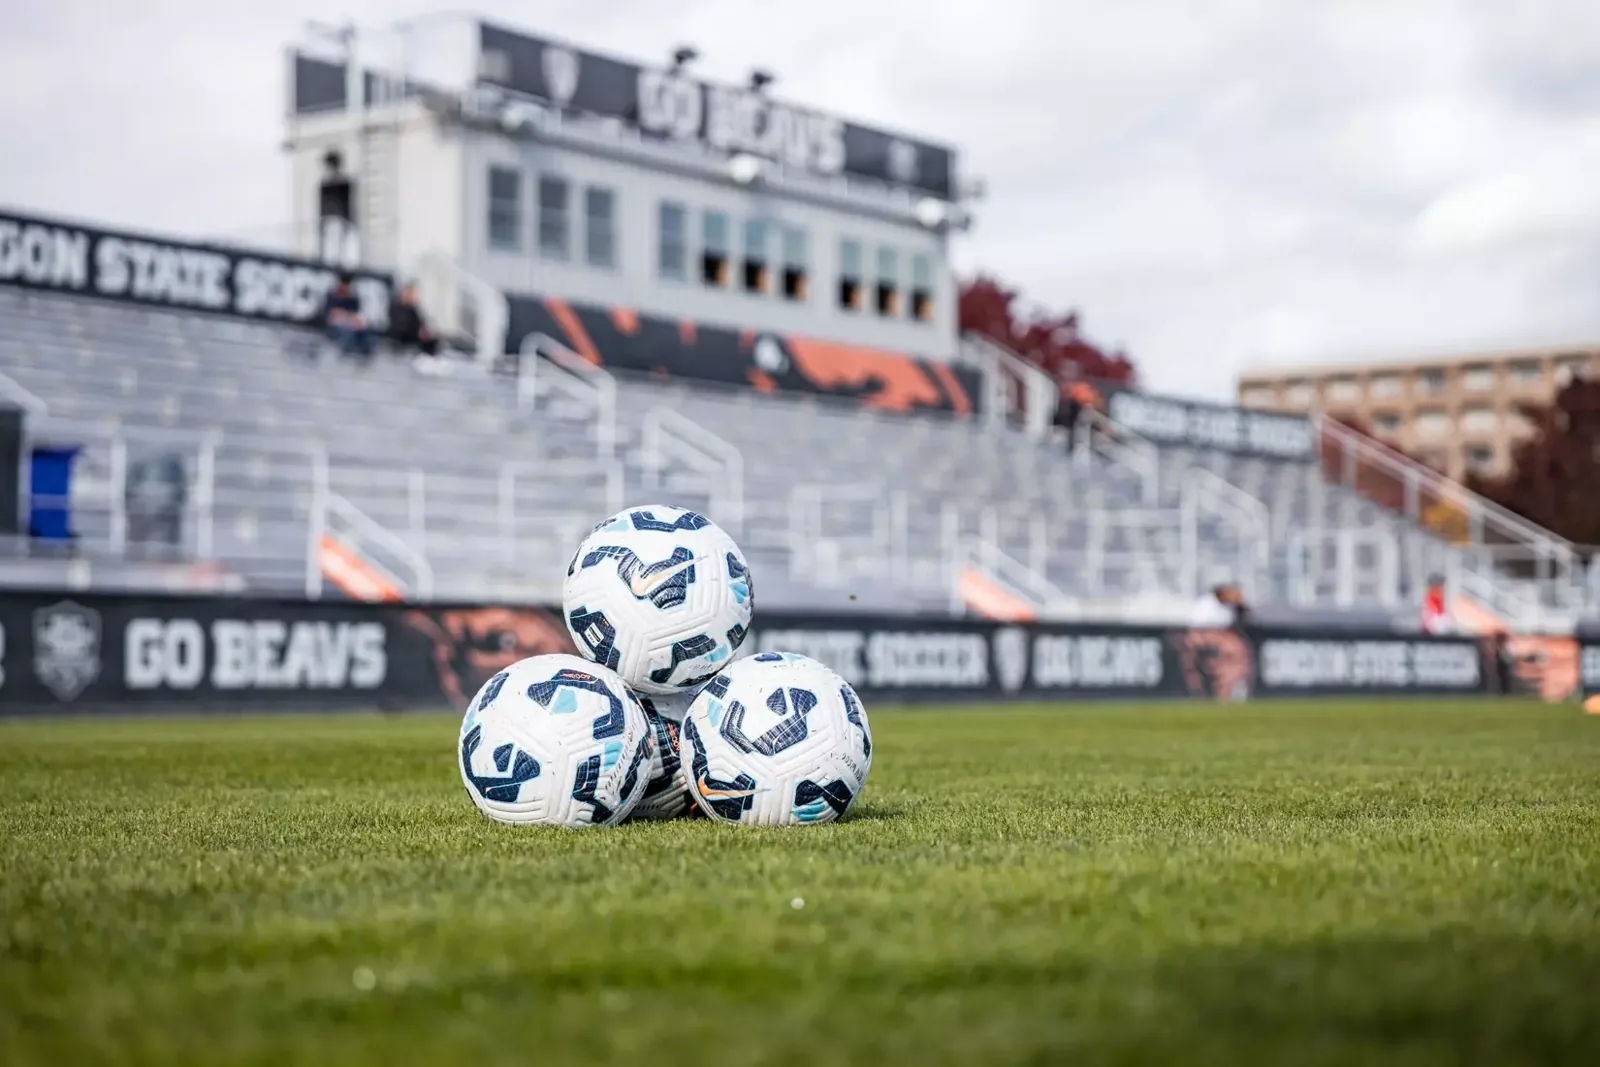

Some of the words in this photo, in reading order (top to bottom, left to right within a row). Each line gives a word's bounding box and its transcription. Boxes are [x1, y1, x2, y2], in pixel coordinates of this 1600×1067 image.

[95, 237, 231, 309] STATE
[235, 258, 391, 331] SOCR
[124, 618, 205, 689] GO
[211, 619, 387, 689] BEAVS
